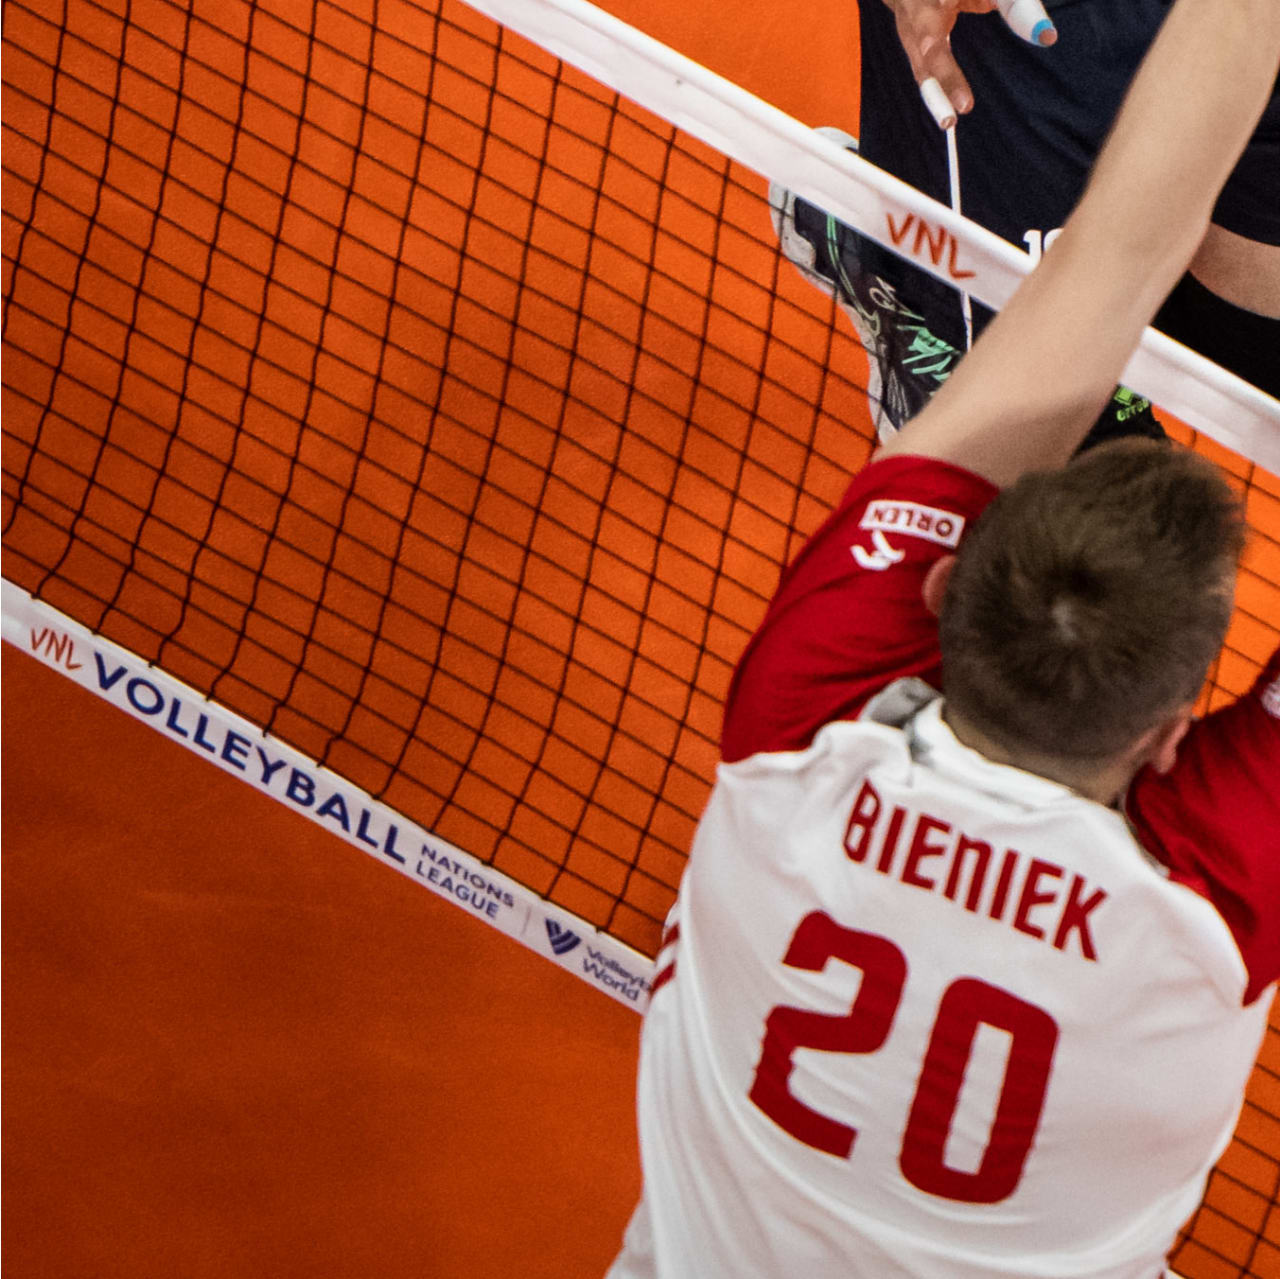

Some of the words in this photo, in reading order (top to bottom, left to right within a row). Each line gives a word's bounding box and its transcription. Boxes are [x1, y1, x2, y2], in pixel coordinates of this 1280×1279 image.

[887, 213, 976, 279] VNL
[874, 508, 954, 537] ORLEN
[31, 628, 83, 670] VNL
[94, 651, 406, 864] VOLLEYBALL
[415, 859, 500, 918] LEAGUE
[421, 843, 514, 908] NATIONS
[843, 778, 1111, 962] BIENIEK
[587, 945, 652, 991] Volleyb
[748, 909, 1061, 1205] 20
